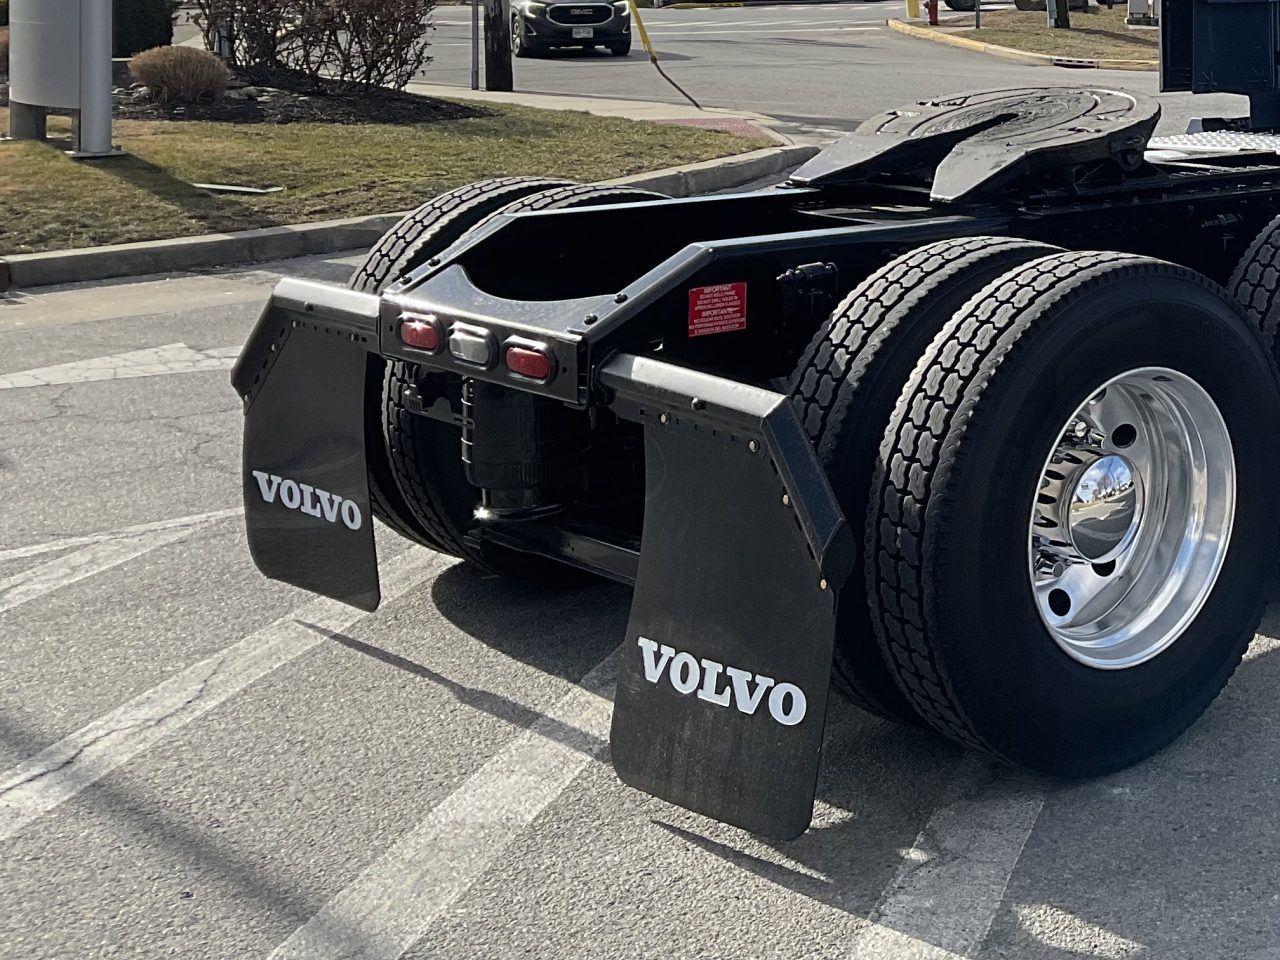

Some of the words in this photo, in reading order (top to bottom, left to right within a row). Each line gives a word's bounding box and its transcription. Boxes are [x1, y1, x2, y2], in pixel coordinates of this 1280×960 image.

[704, 284, 732, 293] IMPORTANT
[252, 470, 362, 530] VOLVO
[638, 636, 807, 726] VOLVO
